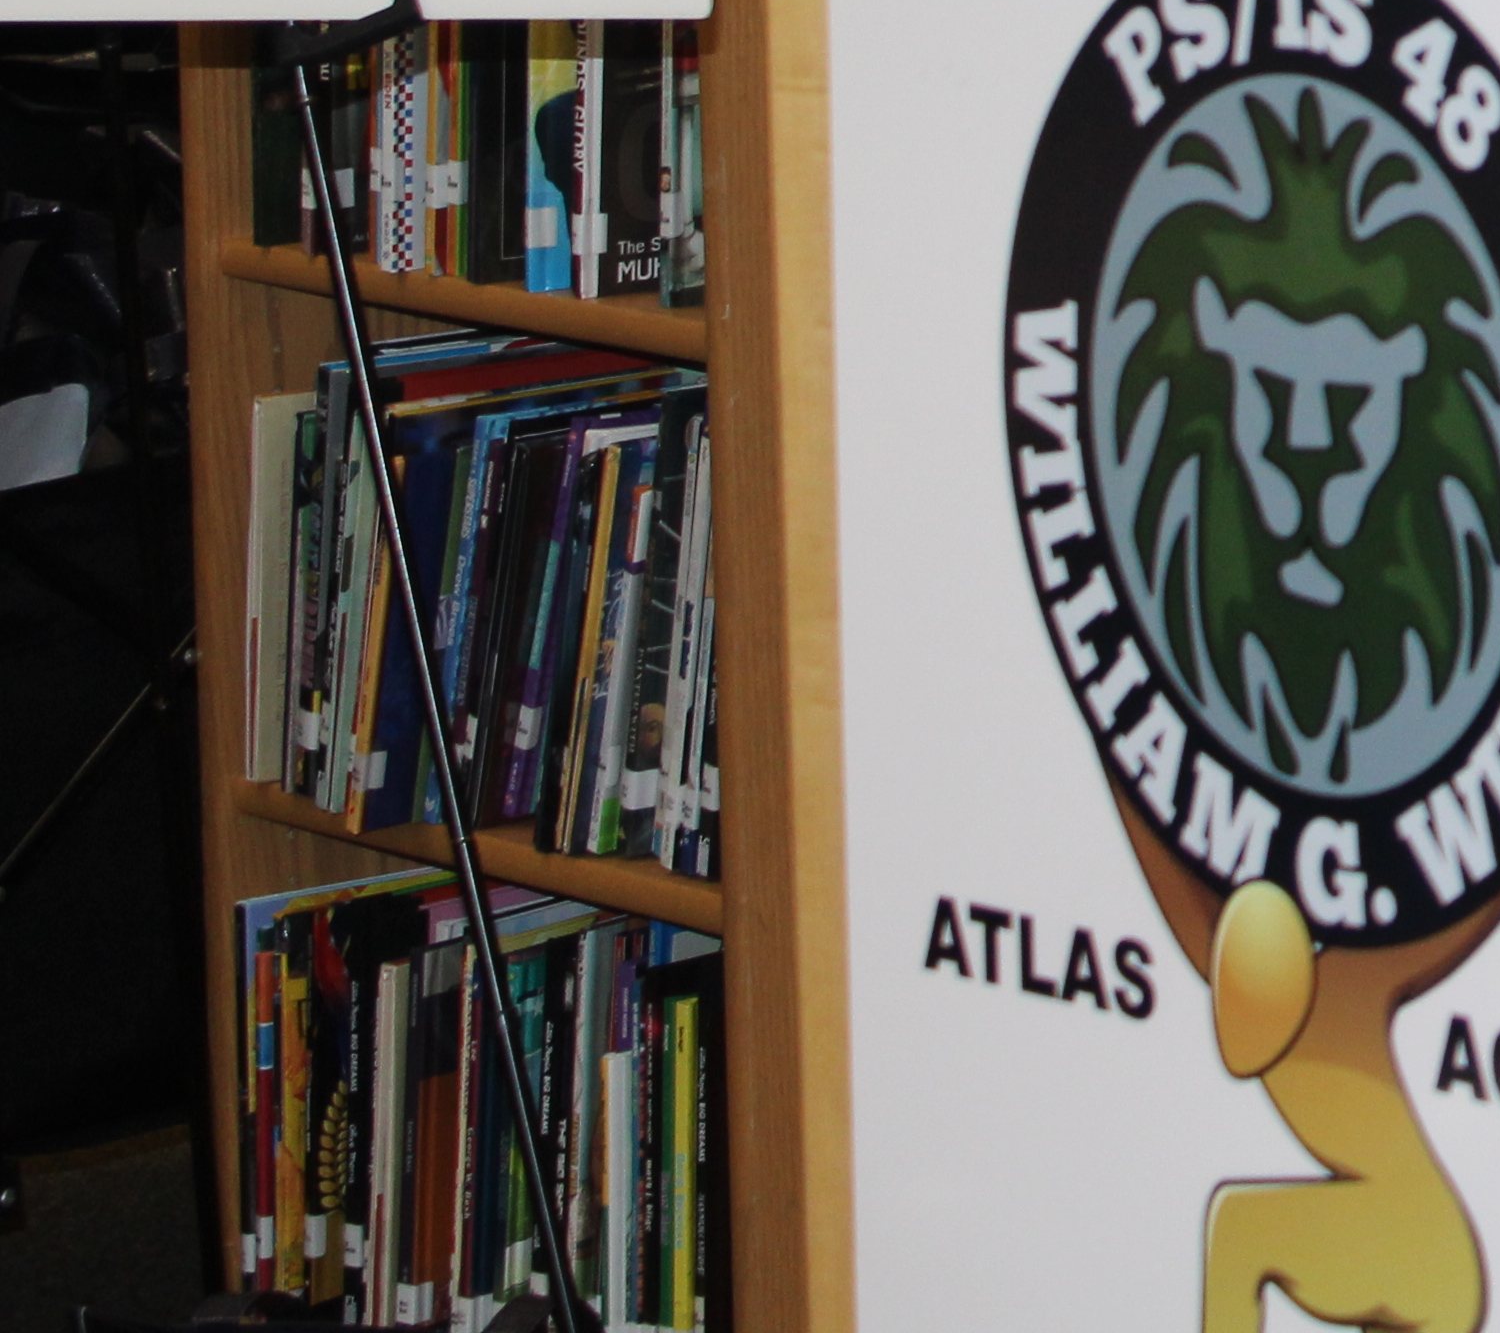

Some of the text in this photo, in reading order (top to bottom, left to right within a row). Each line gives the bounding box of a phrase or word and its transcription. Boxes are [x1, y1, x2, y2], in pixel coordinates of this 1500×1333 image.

[1012, 298, 1282, 884] WILLIAM
[1293, 812, 1398, 928] G.
[924, 894, 1158, 1022] ATLAS
